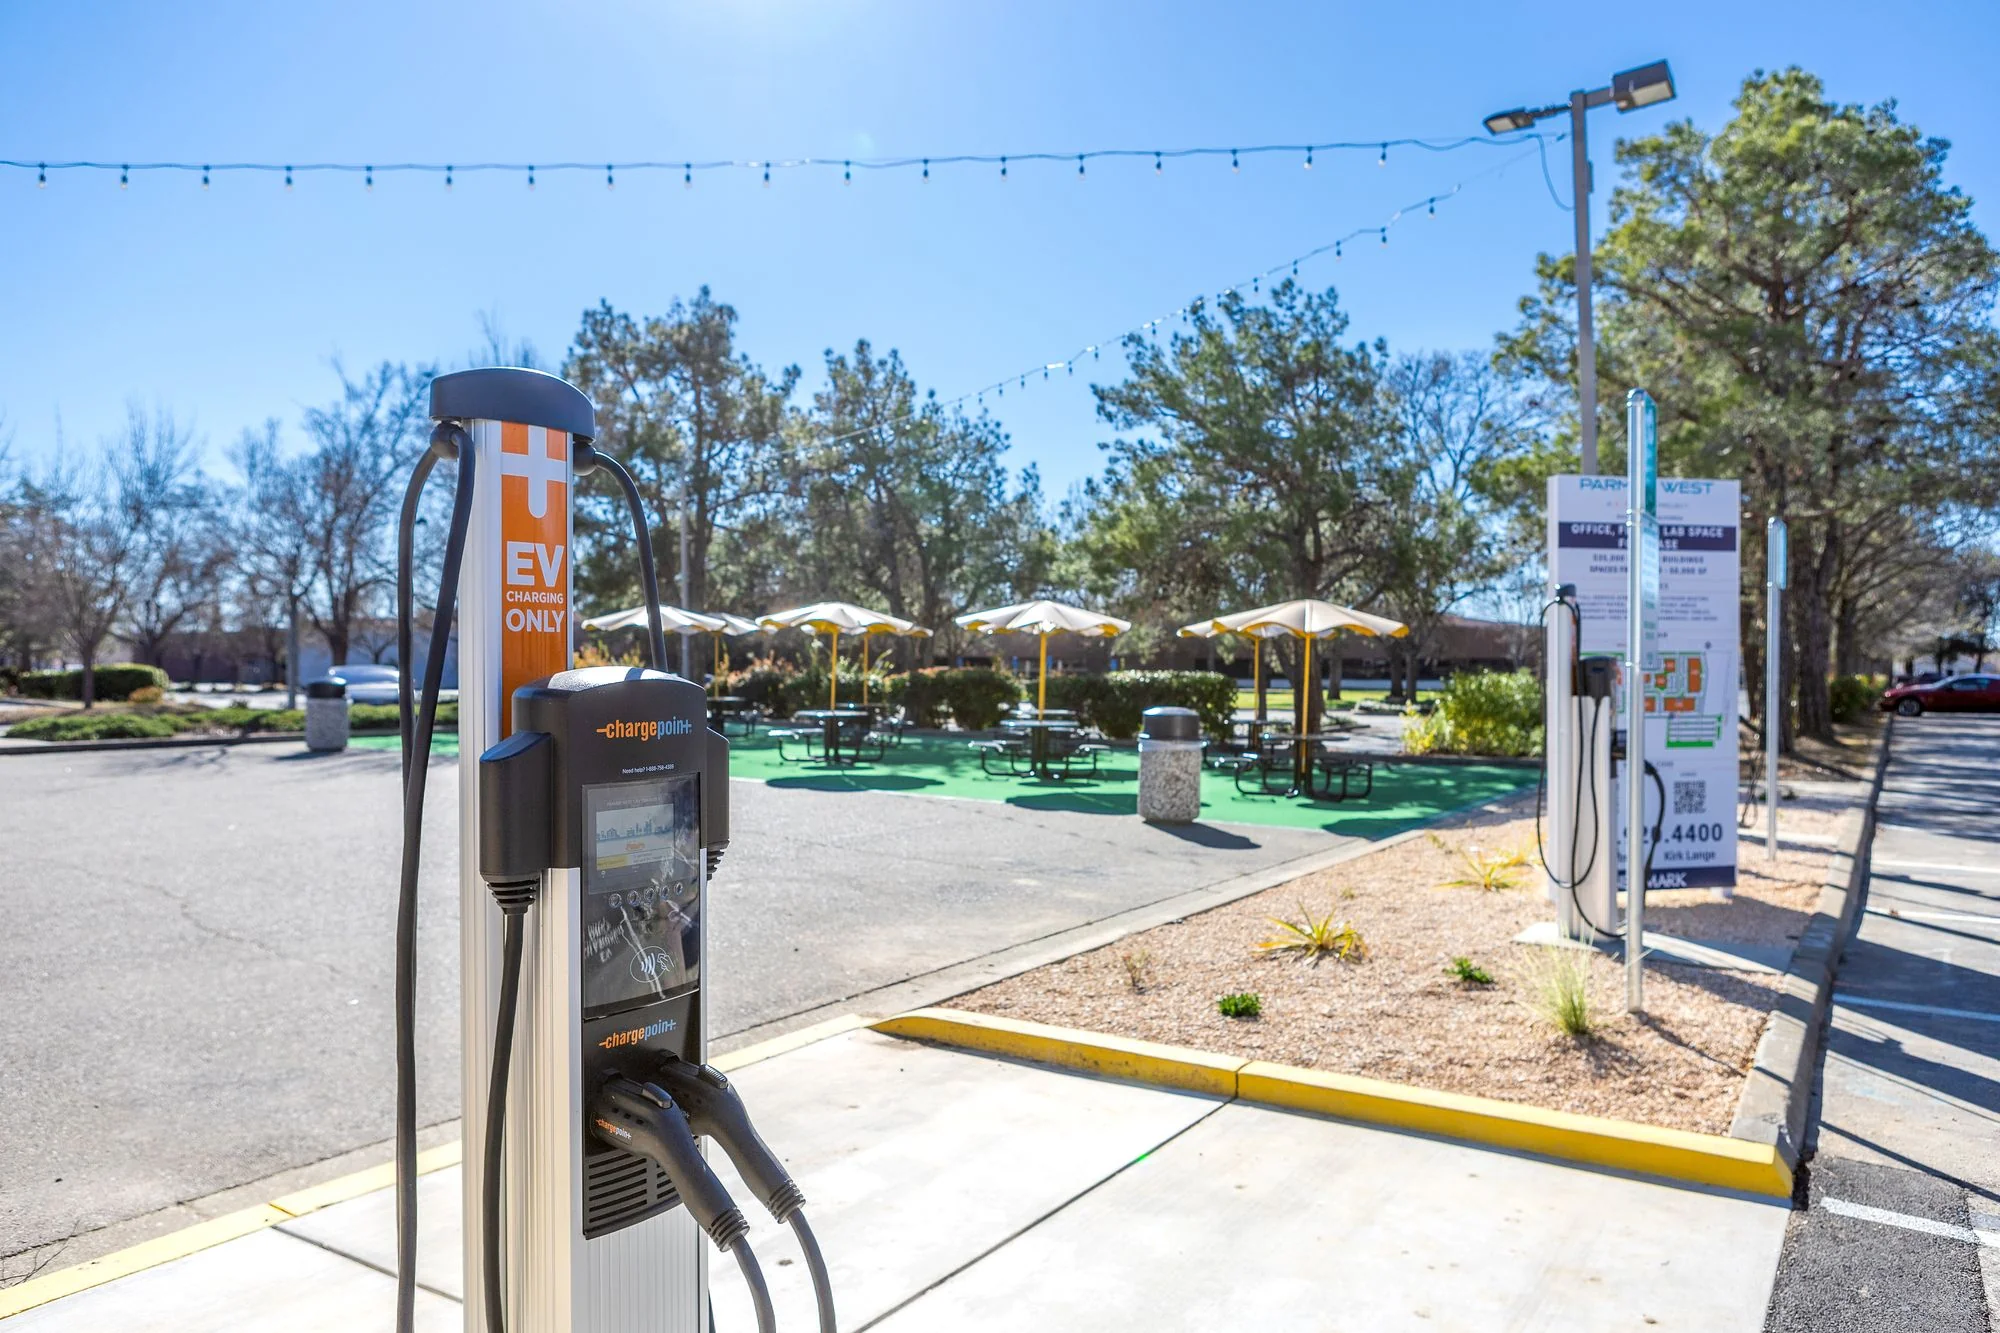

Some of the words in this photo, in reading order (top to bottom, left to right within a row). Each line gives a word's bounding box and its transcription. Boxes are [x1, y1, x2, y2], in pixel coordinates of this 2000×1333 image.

[1580, 478, 1628, 491] PARM
[1661, 481, 1714, 494] WEST
[1571, 523, 1616, 536] OFFICE,
[1663, 527, 1685, 537] LAB
[1687, 528, 1724, 539] SPACE
[507, 541, 564, 587] EV
[506, 590, 563, 604] CHARGING
[506, 608, 565, 633] ONLY
[1664, 851, 1683, 861] Kirk
[1686, 850, 1716, 862] Lange
